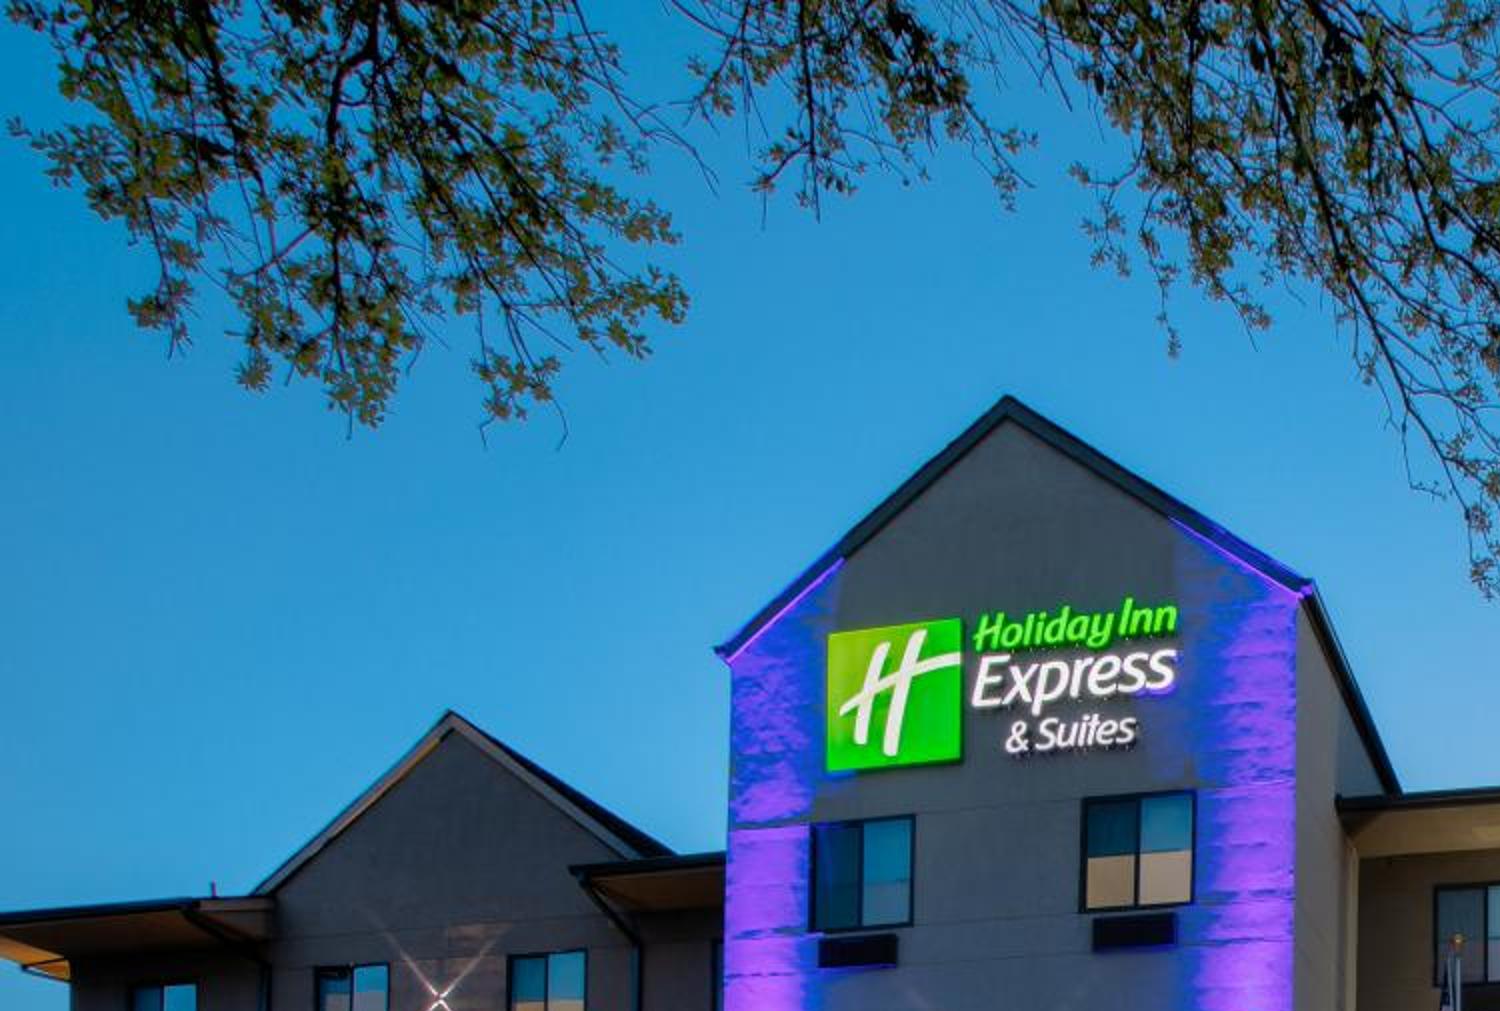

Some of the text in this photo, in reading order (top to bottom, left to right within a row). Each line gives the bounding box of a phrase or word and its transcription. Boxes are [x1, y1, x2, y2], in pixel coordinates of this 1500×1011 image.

[973, 597, 1178, 651] Holiday Inn
[971, 648, 1177, 716] Express
[1005, 715, 1137, 753] & Suites
